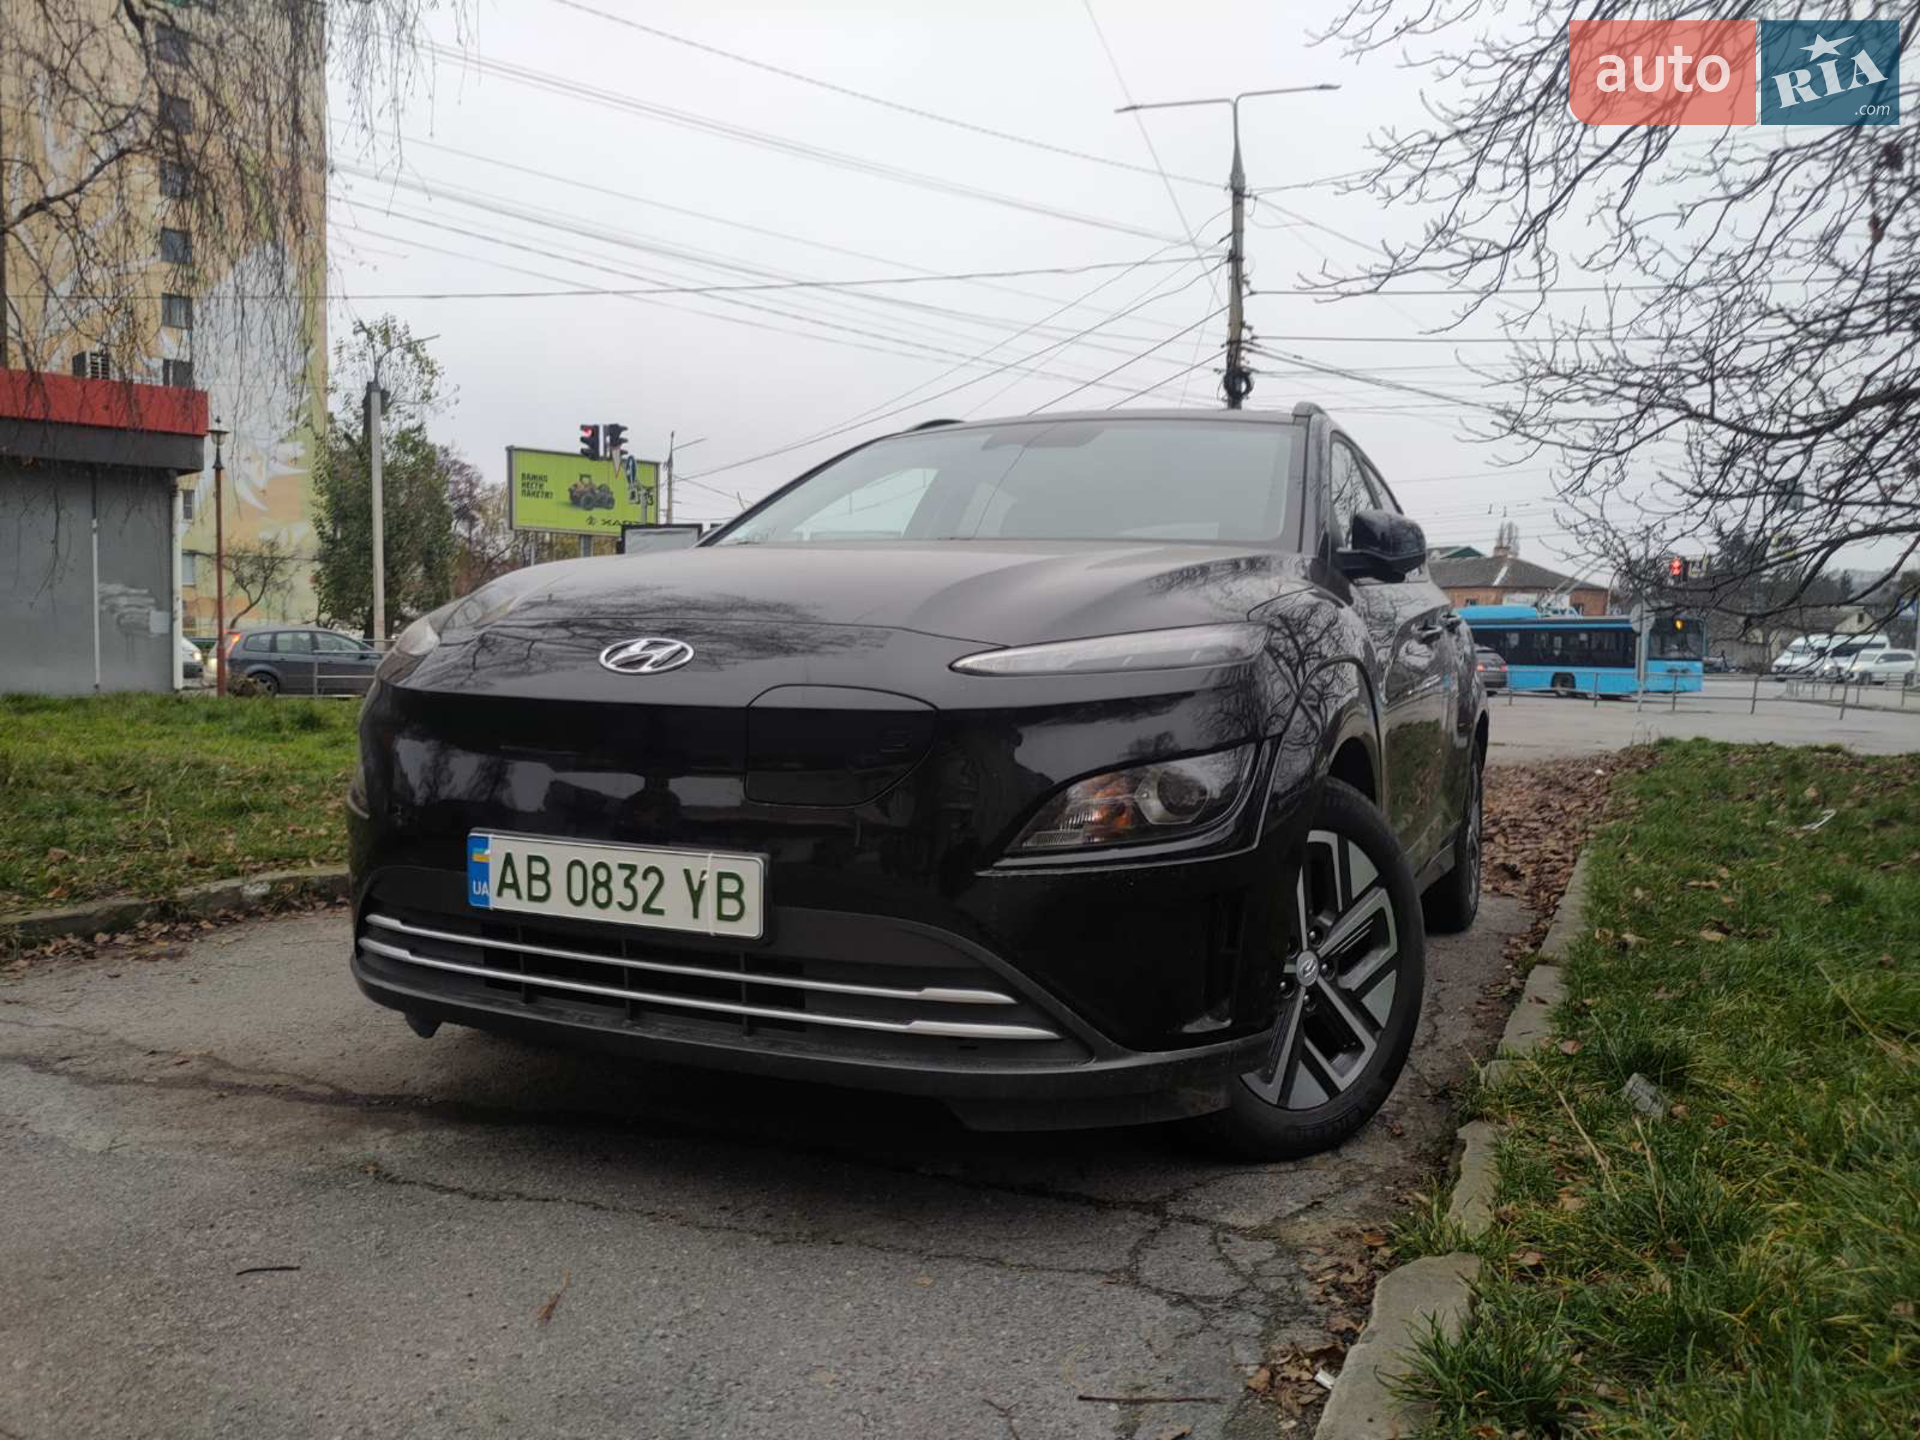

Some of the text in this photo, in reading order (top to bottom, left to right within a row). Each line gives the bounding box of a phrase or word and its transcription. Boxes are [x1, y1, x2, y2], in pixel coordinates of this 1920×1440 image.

[472, 880, 489, 897] UA
[496, 852, 746, 923] AB 0832 YB
